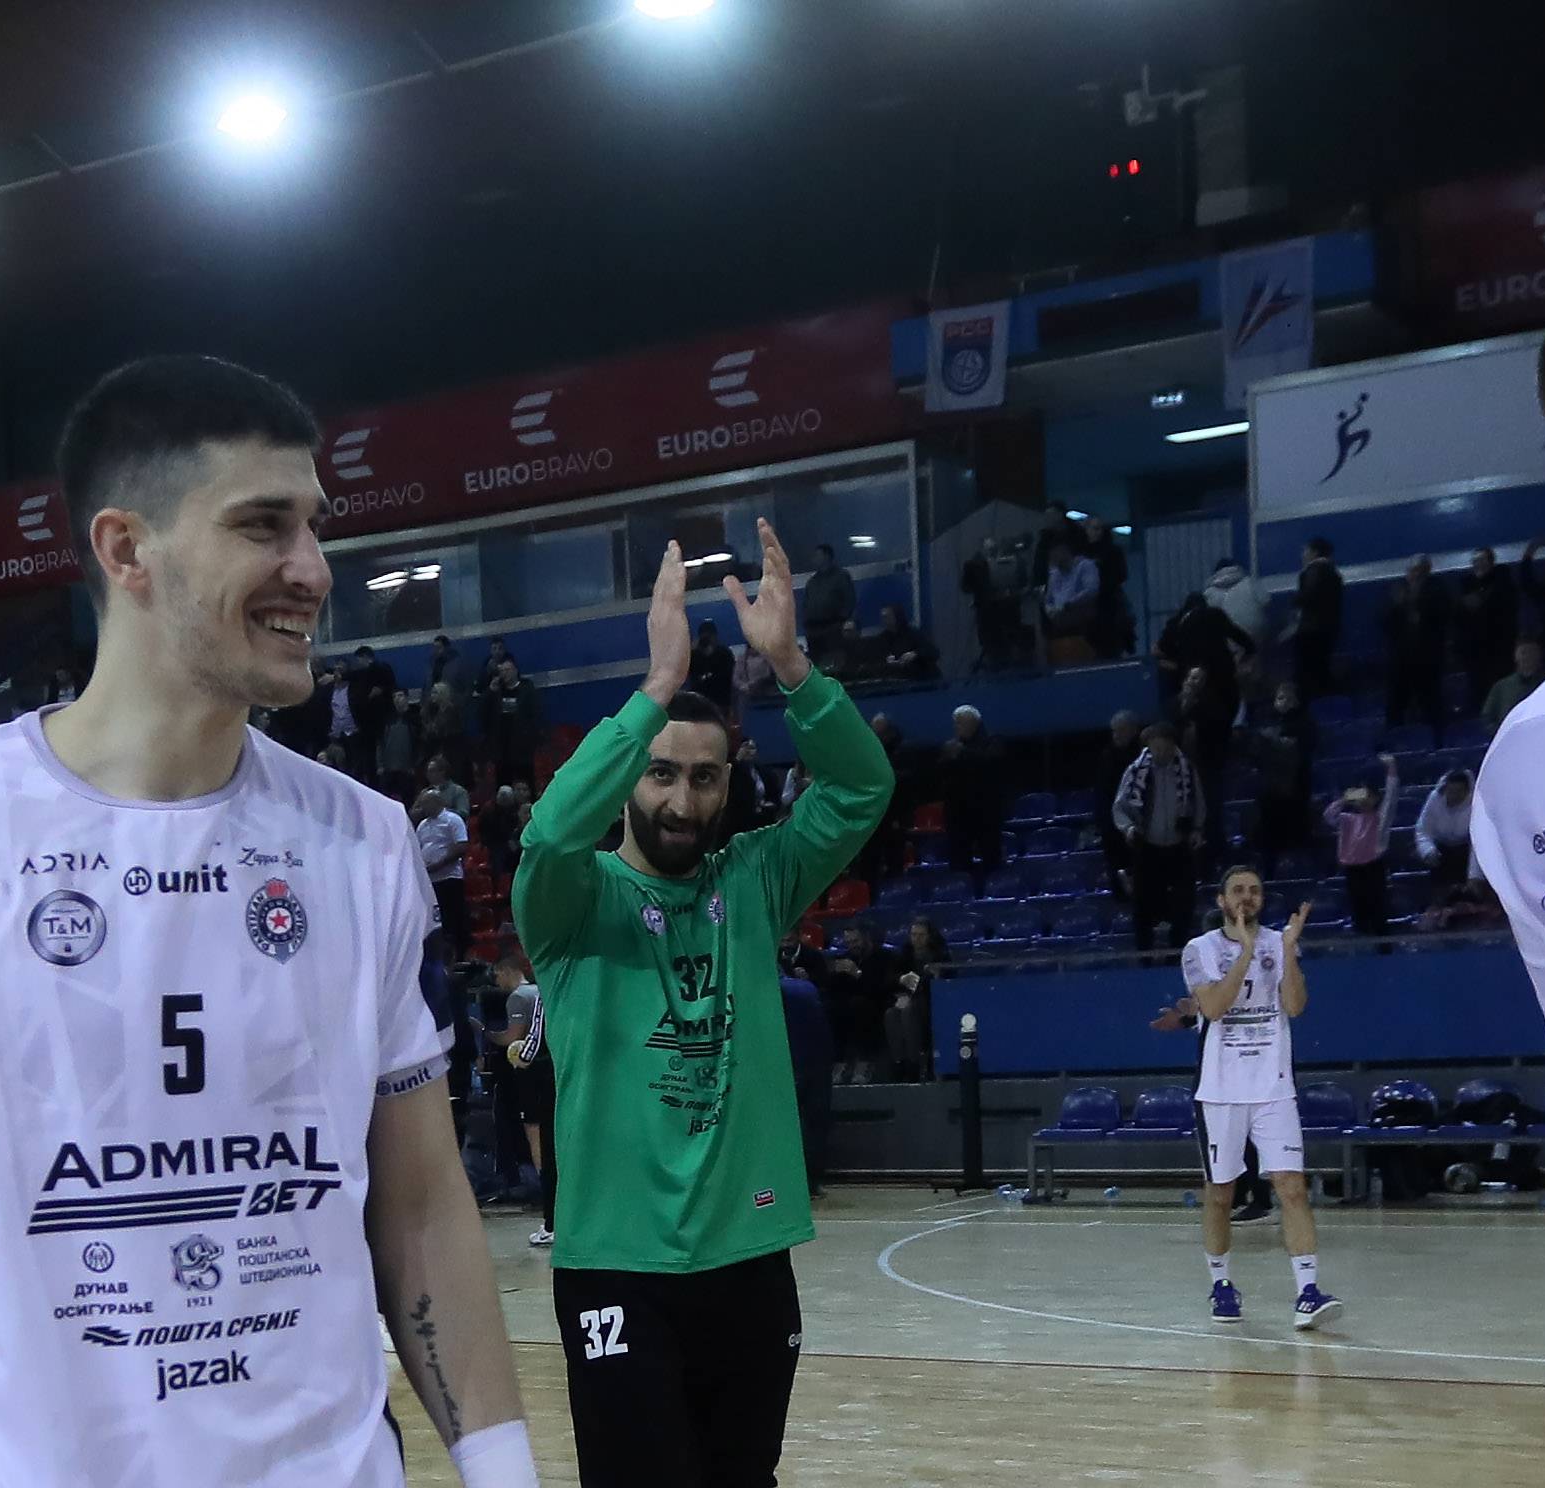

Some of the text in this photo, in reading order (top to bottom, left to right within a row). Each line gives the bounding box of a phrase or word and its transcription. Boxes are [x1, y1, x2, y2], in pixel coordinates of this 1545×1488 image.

[657, 407, 822, 460] EUROBRAVO
[464, 448, 613, 495] EUROBRAVO
[328, 482, 425, 519] OBRAVO
[20, 852, 110, 875] ADRIA
[158, 864, 228, 893] unit
[43, 916, 90, 935] T&M
[673, 952, 718, 1003] 32
[1244, 979, 1253, 1000] 7
[161, 993, 207, 1095] 5
[392, 1066, 433, 1095] unit
[41, 1126, 341, 1192] ADMIRAL
[1209, 1143, 1219, 1165] 7
[245, 1179, 342, 1217] BET
[73, 1281, 129, 1299] ДУНАВ
[53, 1300, 154, 1319] ОСИГУРАЊЕ
[134, 1308, 301, 1347] ПОШТА СРБИЈЕ
[579, 1306, 628, 1360] 32
[156, 1350, 252, 1401] jazak
